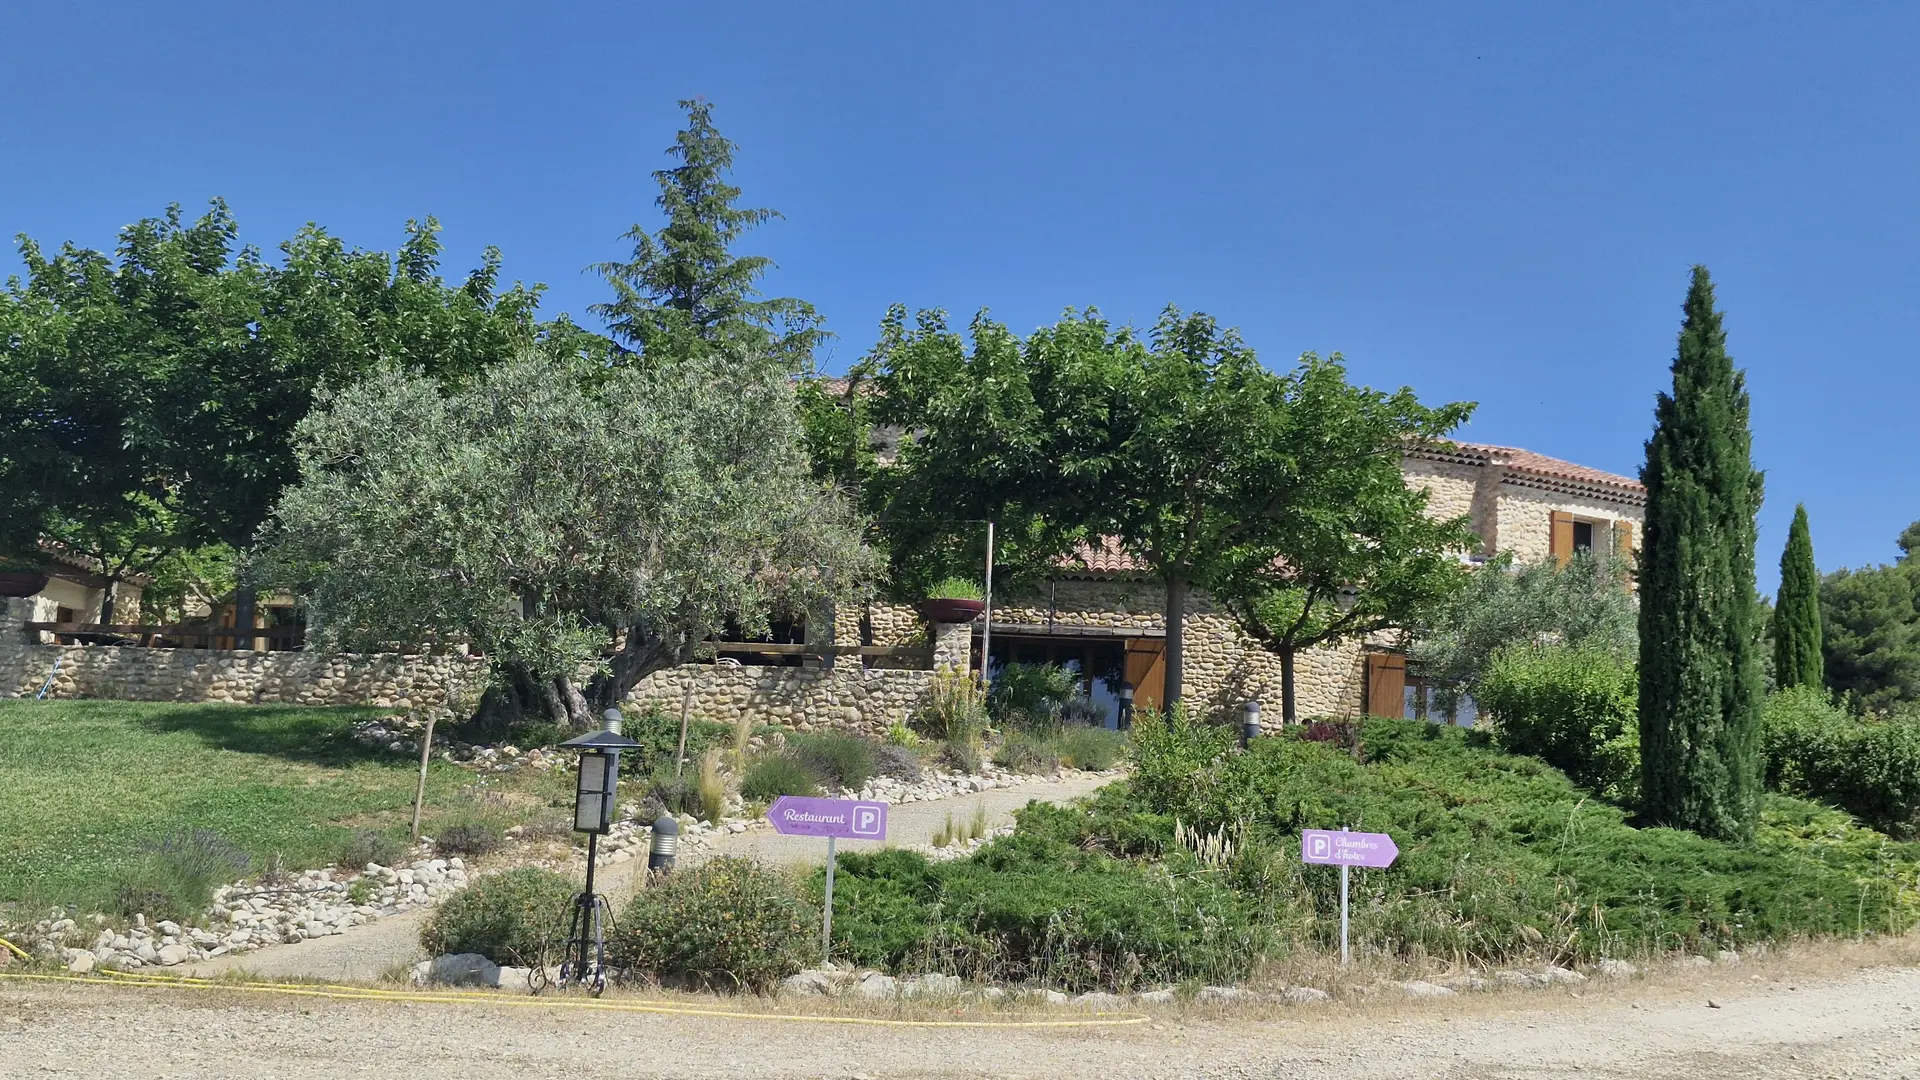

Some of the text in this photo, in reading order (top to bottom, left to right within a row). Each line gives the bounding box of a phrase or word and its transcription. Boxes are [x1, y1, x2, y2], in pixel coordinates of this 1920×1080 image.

[784, 808, 846, 824] Restaurant
[861, 811, 875, 829] P
[1314, 839, 1326, 854] P
[1335, 836, 1379, 850] Chambres
